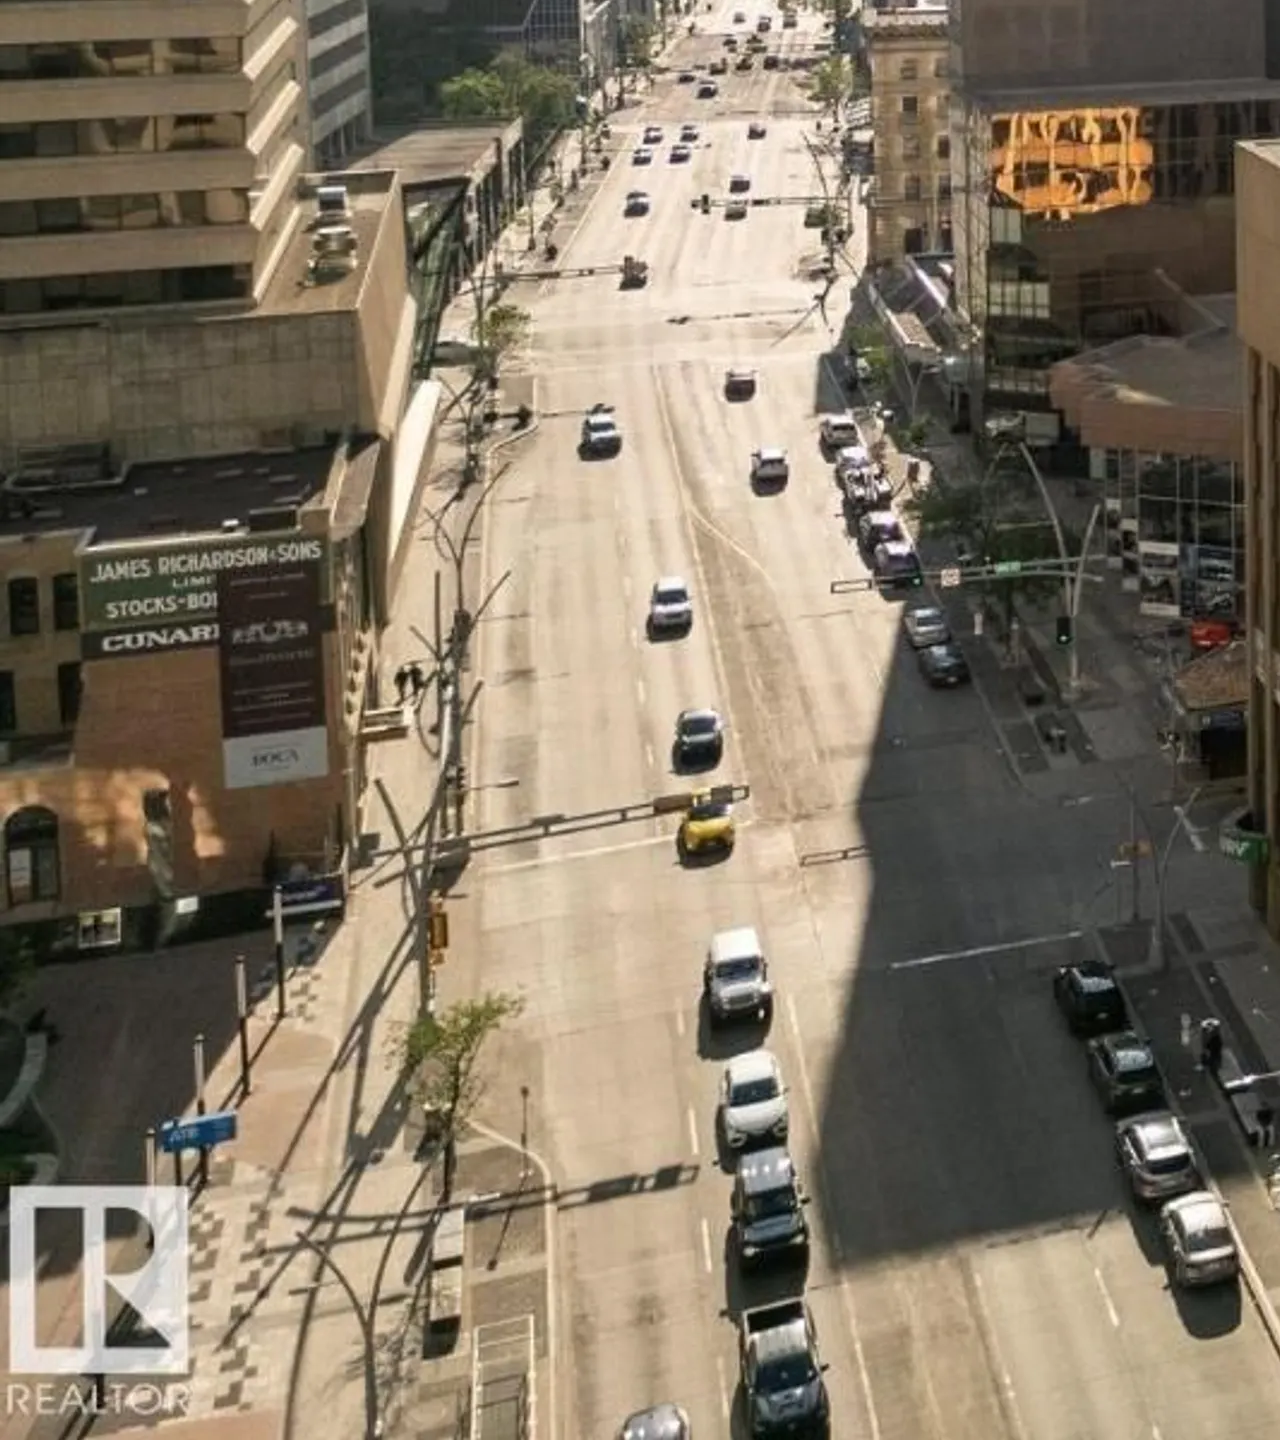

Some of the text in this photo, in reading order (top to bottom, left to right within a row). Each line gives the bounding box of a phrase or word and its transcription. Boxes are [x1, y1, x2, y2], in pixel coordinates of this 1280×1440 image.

[90, 558, 150, 583] JAMES
[158, 546, 268, 575] RICHARDSON
[278, 540, 322, 563] SONS
